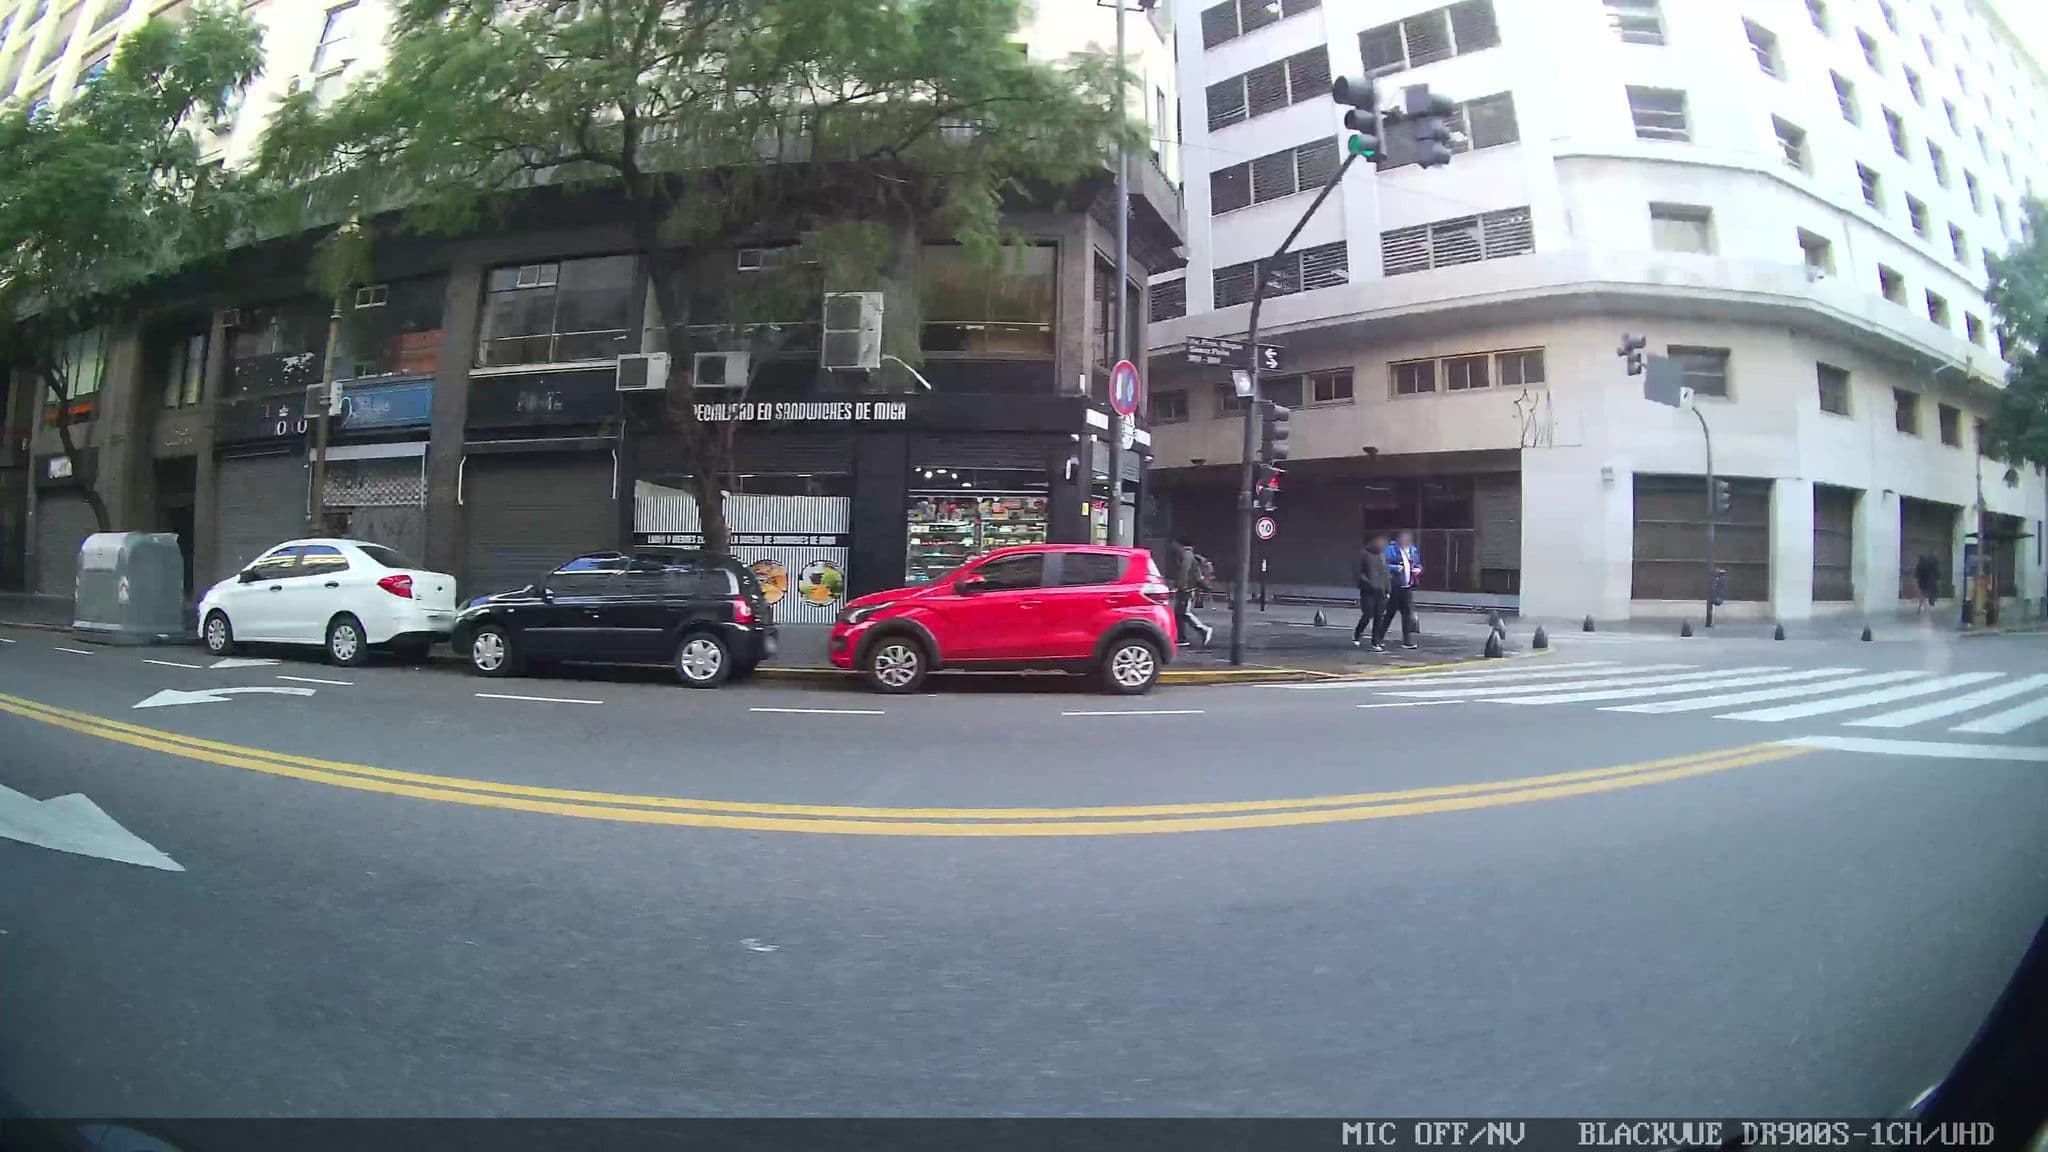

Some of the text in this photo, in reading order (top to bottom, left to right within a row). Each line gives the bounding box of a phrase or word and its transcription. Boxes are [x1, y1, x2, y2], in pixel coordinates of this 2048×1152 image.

[693, 402, 906, 421] ECIALIAD EN SANDWICHES DE MIGA
